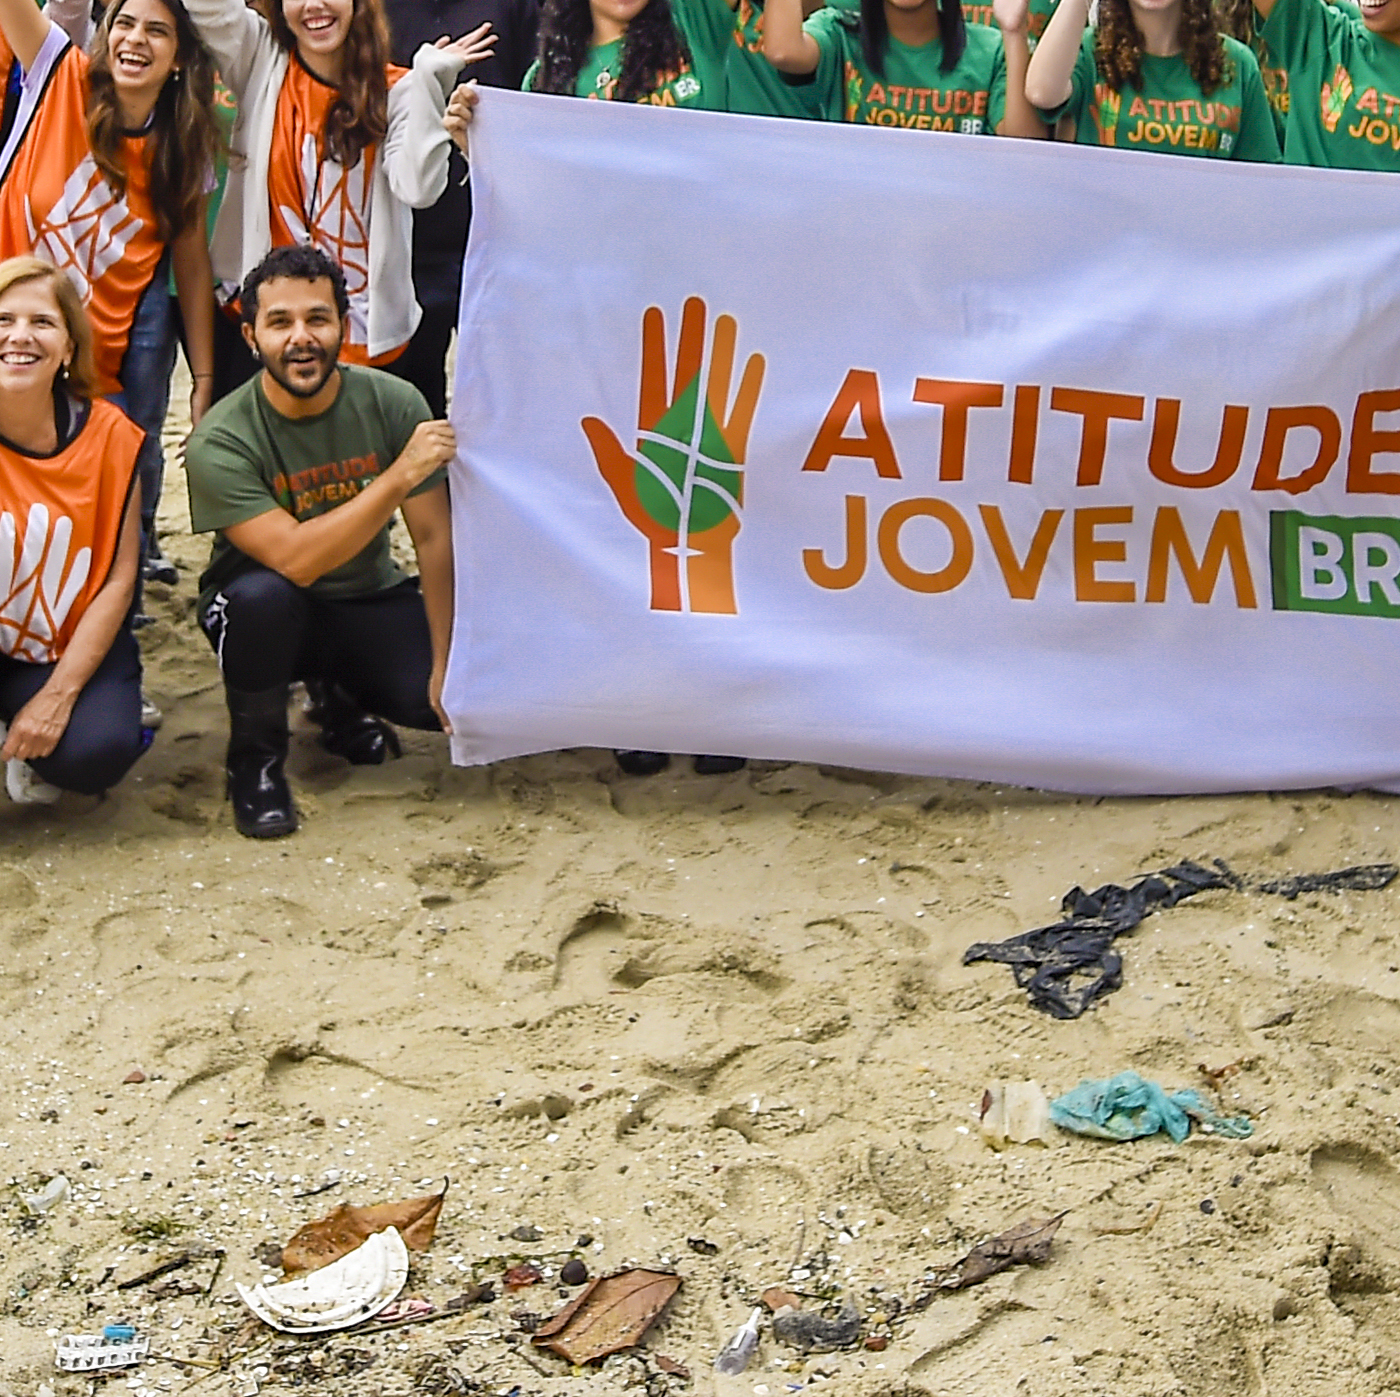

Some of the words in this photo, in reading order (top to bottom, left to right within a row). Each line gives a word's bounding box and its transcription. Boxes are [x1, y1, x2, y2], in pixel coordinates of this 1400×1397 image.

[675, 77, 701, 98] BR
[866, 82, 989, 116] ATITUDE
[1127, 120, 1218, 150] JOVEM
[802, 494, 1259, 610] JOVEM
